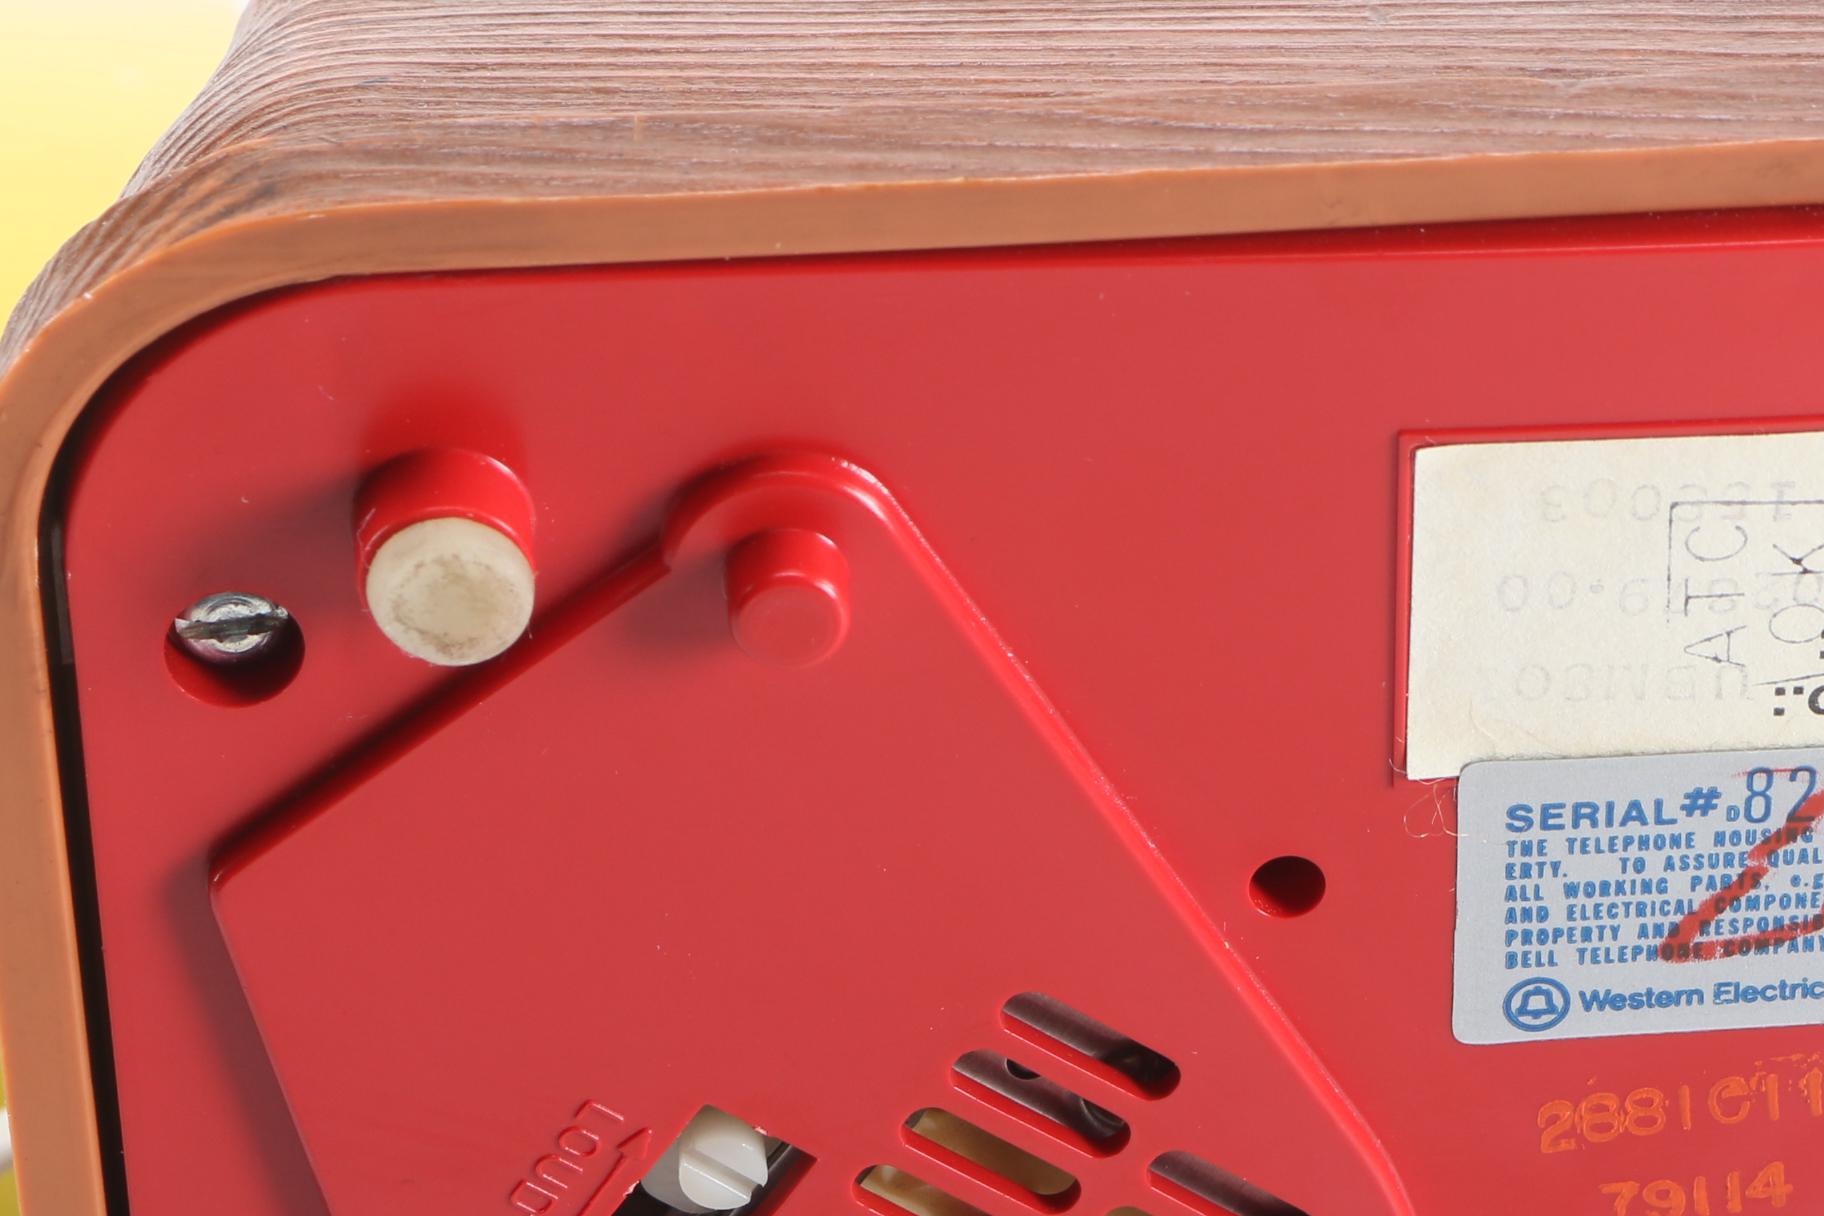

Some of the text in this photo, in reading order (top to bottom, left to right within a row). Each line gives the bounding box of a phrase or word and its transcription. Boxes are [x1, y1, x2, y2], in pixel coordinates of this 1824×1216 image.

[1506, 838, 1548, 858] THE
[1566, 832, 1696, 855] TELEPHONE
[1505, 860, 1568, 880] ERTY.
[1619, 856, 1646, 875] TO
[1663, 851, 1749, 873] ASSURE
[1504, 884, 1544, 902] ALL
[1563, 877, 1669, 899] WORKING
[1504, 905, 1549, 924] AND
[1567, 898, 1697, 922] ELECTRICAL
[1504, 924, 1621, 946] PROPERTY
[1637, 920, 1681, 940] AND
[1505, 950, 1558, 969] BELL
[1576, 941, 1704, 965] TELEPHONE
[1578, 986, 1705, 1012] Western
